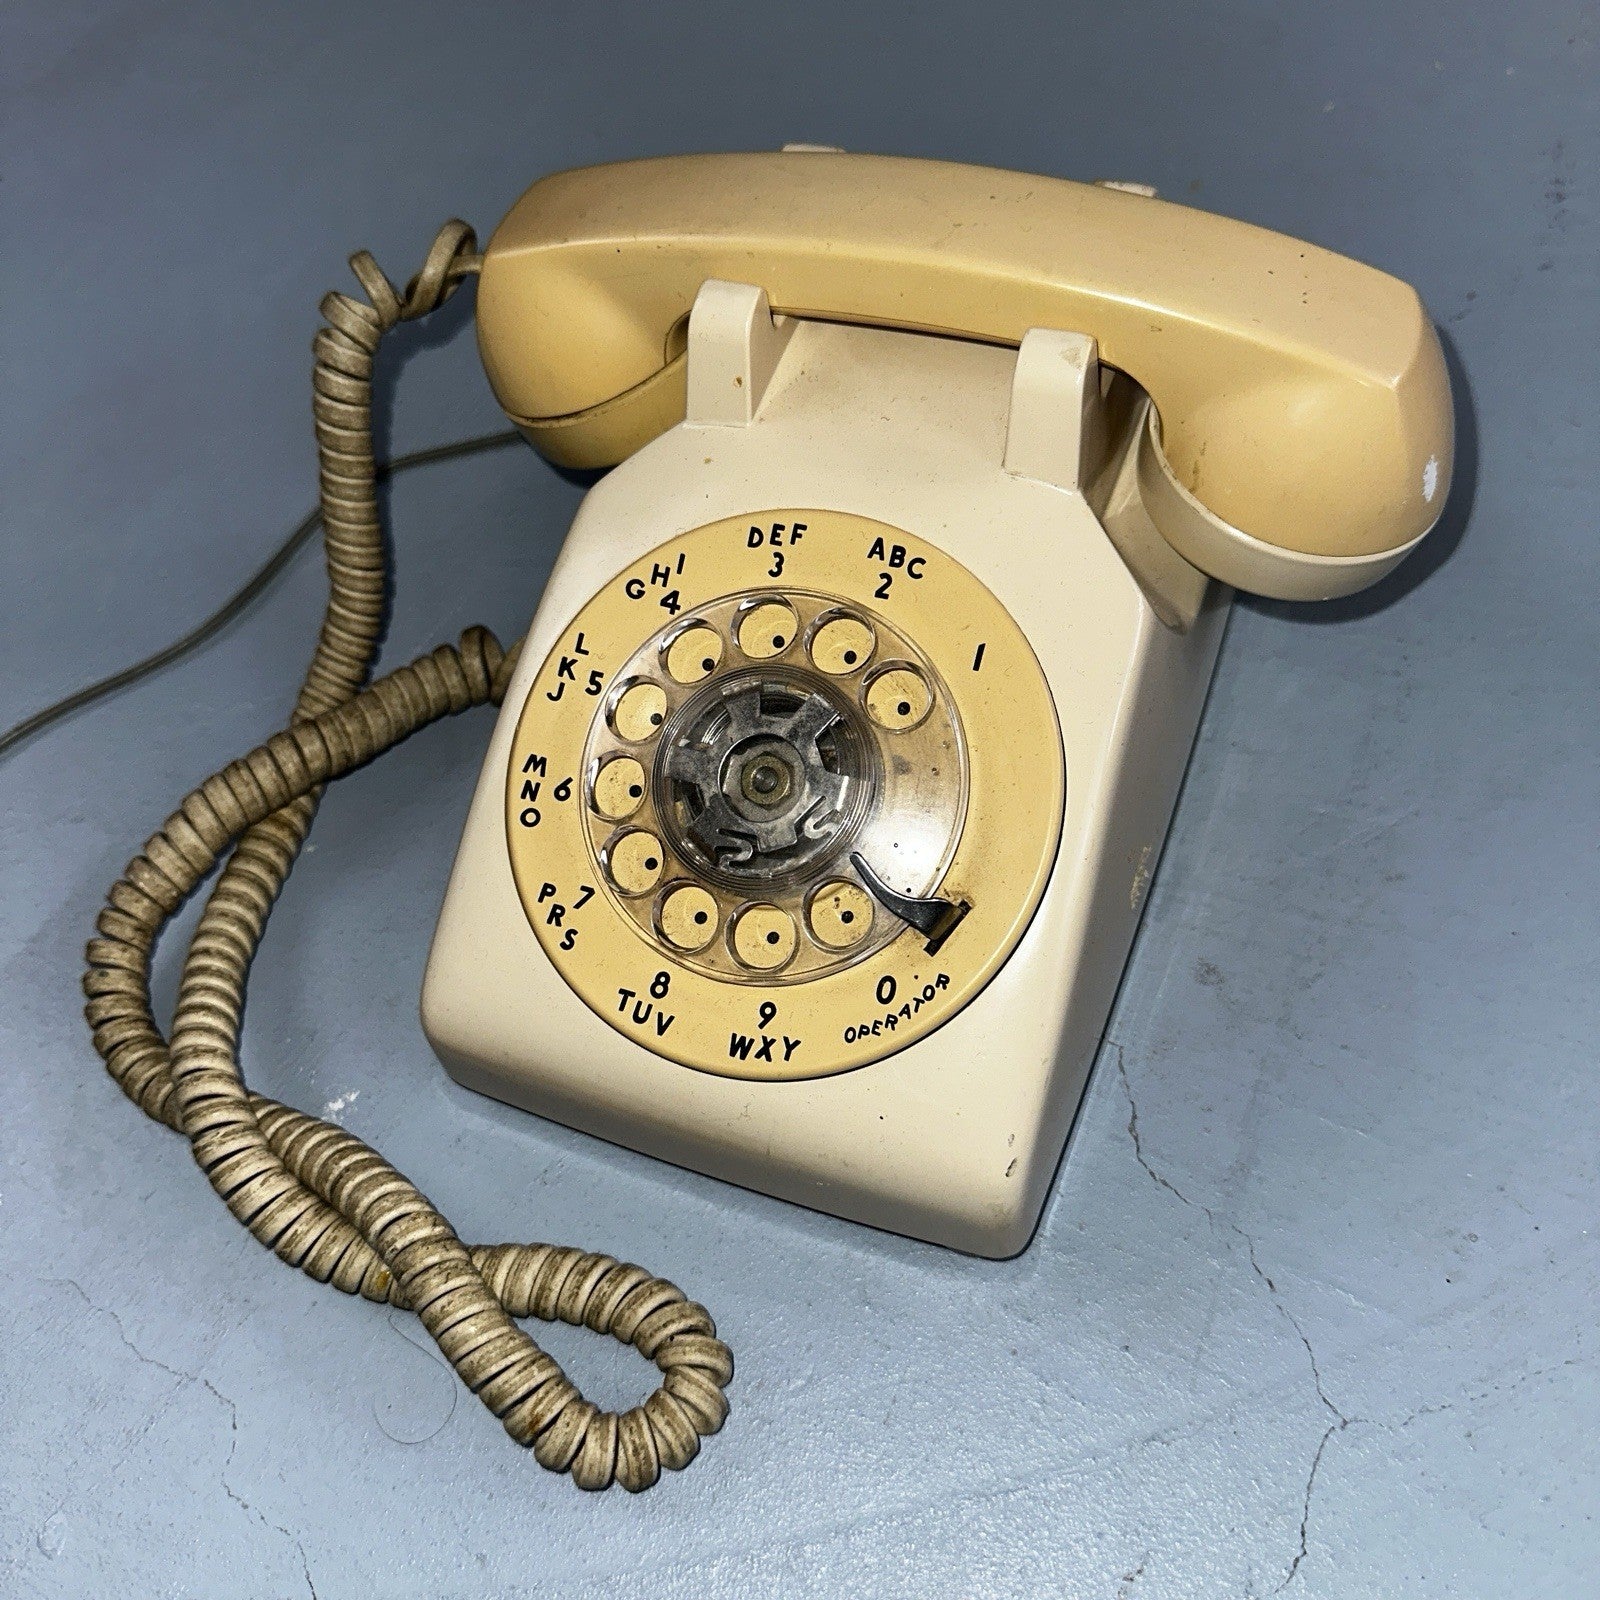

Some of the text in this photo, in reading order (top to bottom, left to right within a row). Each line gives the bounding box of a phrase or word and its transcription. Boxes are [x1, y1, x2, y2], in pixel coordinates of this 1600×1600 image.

[747, 522, 808, 549] DEF
[767, 551, 785, 578] 3
[867, 536, 927, 580] ABC
[625, 553, 686, 600] GHI
[874, 572, 893, 600] 2
[659, 590, 682, 616] 4
[546, 632, 590, 702] JKL
[972, 642, 986, 672] 1
[584, 669, 605, 696] 5
[519, 753, 548, 828] MNO
[553, 776, 574, 802] 6
[572, 885, 596, 910] 7
[537, 882, 579, 951] PRS
[649, 971, 671, 1000] 8
[875, 975, 897, 1005] 0
[618, 988, 676, 1037] TUV
[757, 1001, 777, 1030] 9
[844, 972, 951, 1044] OPERATOR
[729, 1032, 802, 1063] WXY
